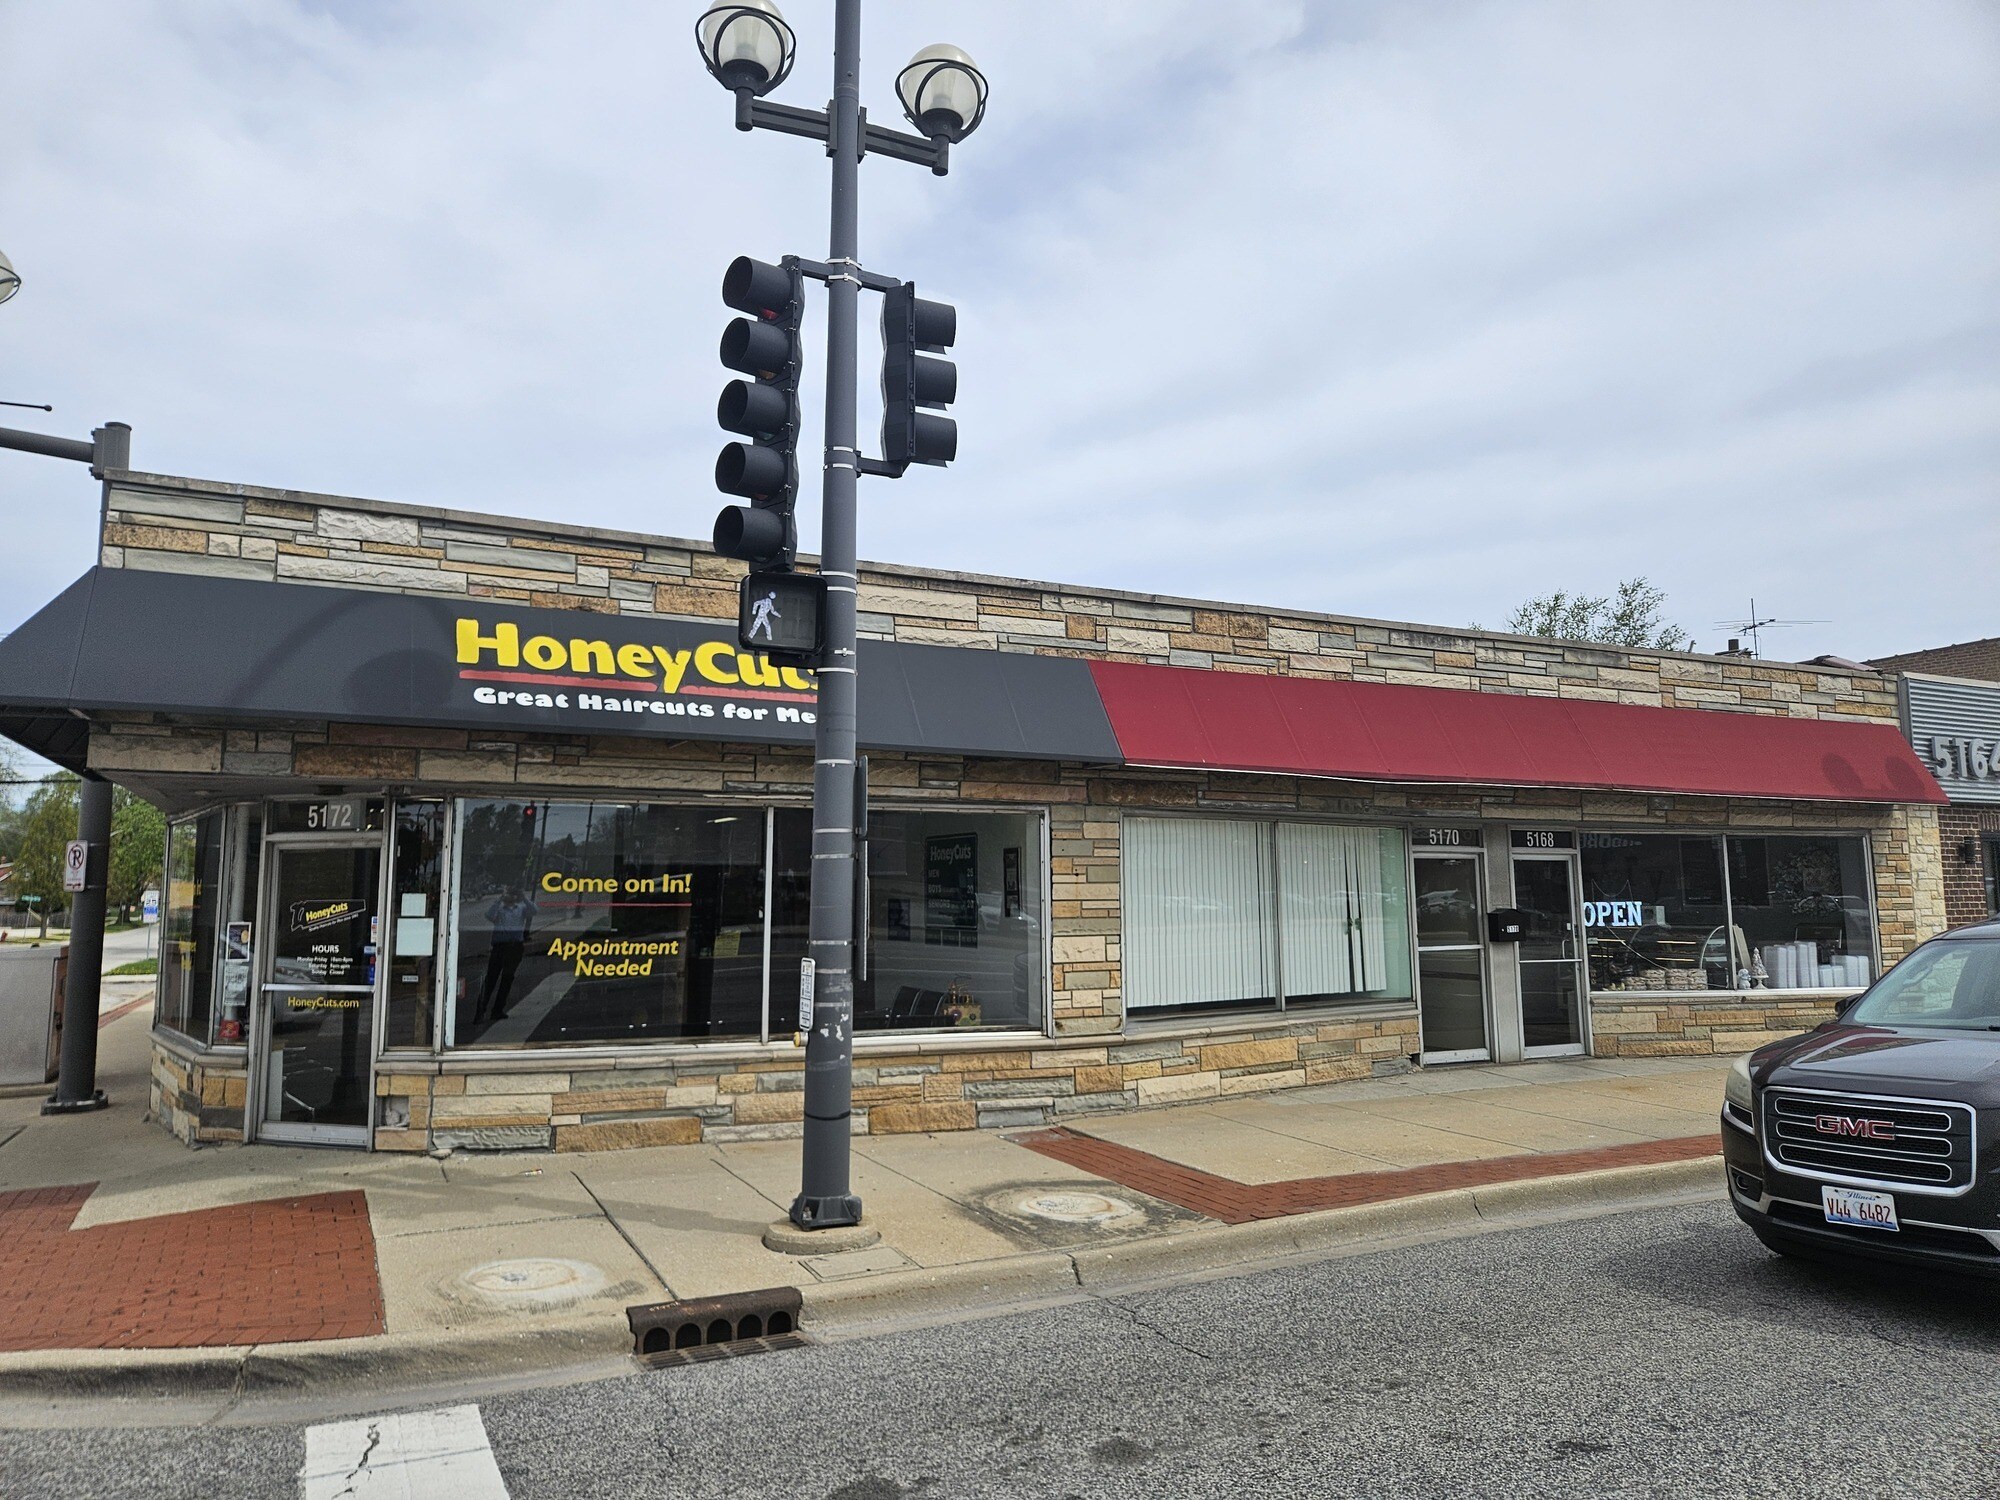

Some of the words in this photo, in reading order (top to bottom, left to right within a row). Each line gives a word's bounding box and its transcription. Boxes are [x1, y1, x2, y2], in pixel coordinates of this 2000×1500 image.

[456, 618, 818, 694] HoneyCut
[473, 687, 569, 708] Great
[578, 694, 716, 718] Haircuts
[722, 703, 768, 722] for
[776, 707, 817, 725] Me
[308, 804, 352, 828] 5172
[1429, 829, 1460, 846] 5170
[1526, 832, 1554, 847] 5168
[930, 844, 972, 864] HoneyCuts
[541, 872, 618, 893] Come
[624, 878, 655, 893] on
[662, 874, 693, 893] In!
[305, 902, 349, 922] HoneyCuts
[1583, 901, 1643, 927] OPEN
[311, 944, 340, 954] HOURS
[547, 938, 679, 961] Appointment
[574, 959, 653, 977] Needed
[287, 996, 360, 1009] HoneyCuts.com
[1815, 1114, 1895, 1140] GMC
[1845, 1191, 1877, 1201] Illinois
[1827, 1198, 1851, 1218] V44
[1860, 1202, 1893, 1225] 6482
